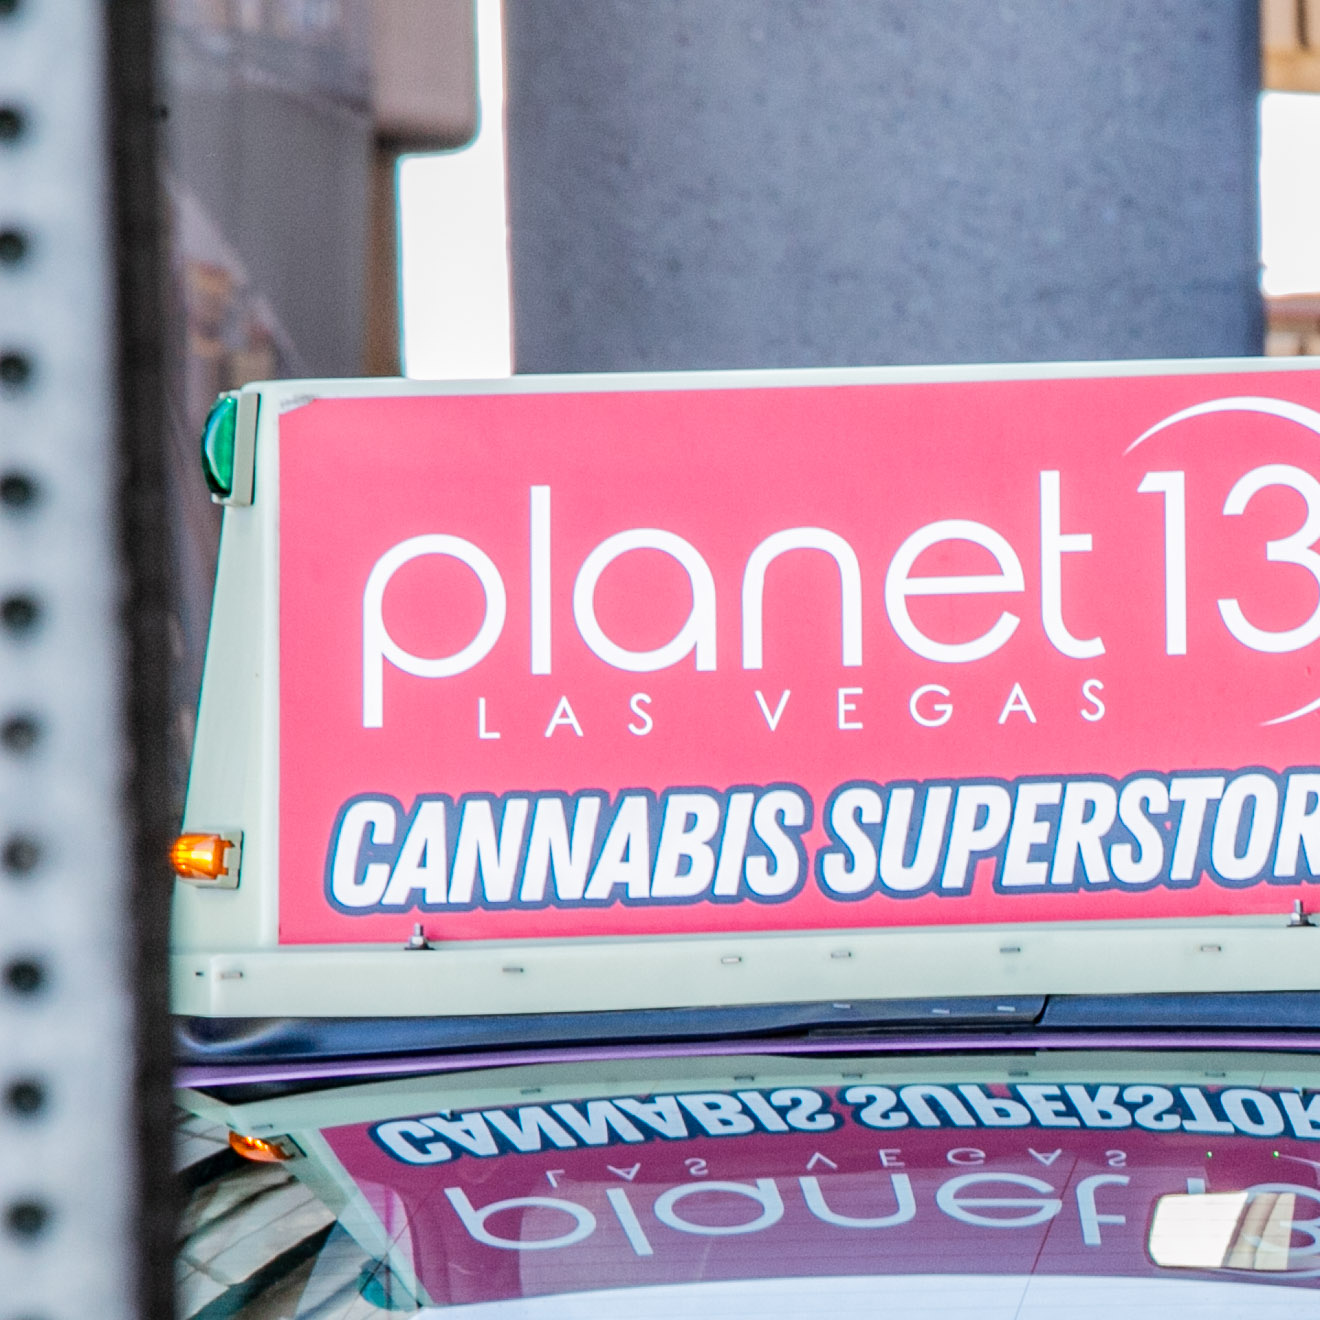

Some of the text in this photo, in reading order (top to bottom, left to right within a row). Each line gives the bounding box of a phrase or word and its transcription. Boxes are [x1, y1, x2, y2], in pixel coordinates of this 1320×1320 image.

[361, 469, 1106, 729] planet
[477, 677, 1106, 740] LAS VEGAS
[338, 788, 805, 908] CANNABIS
